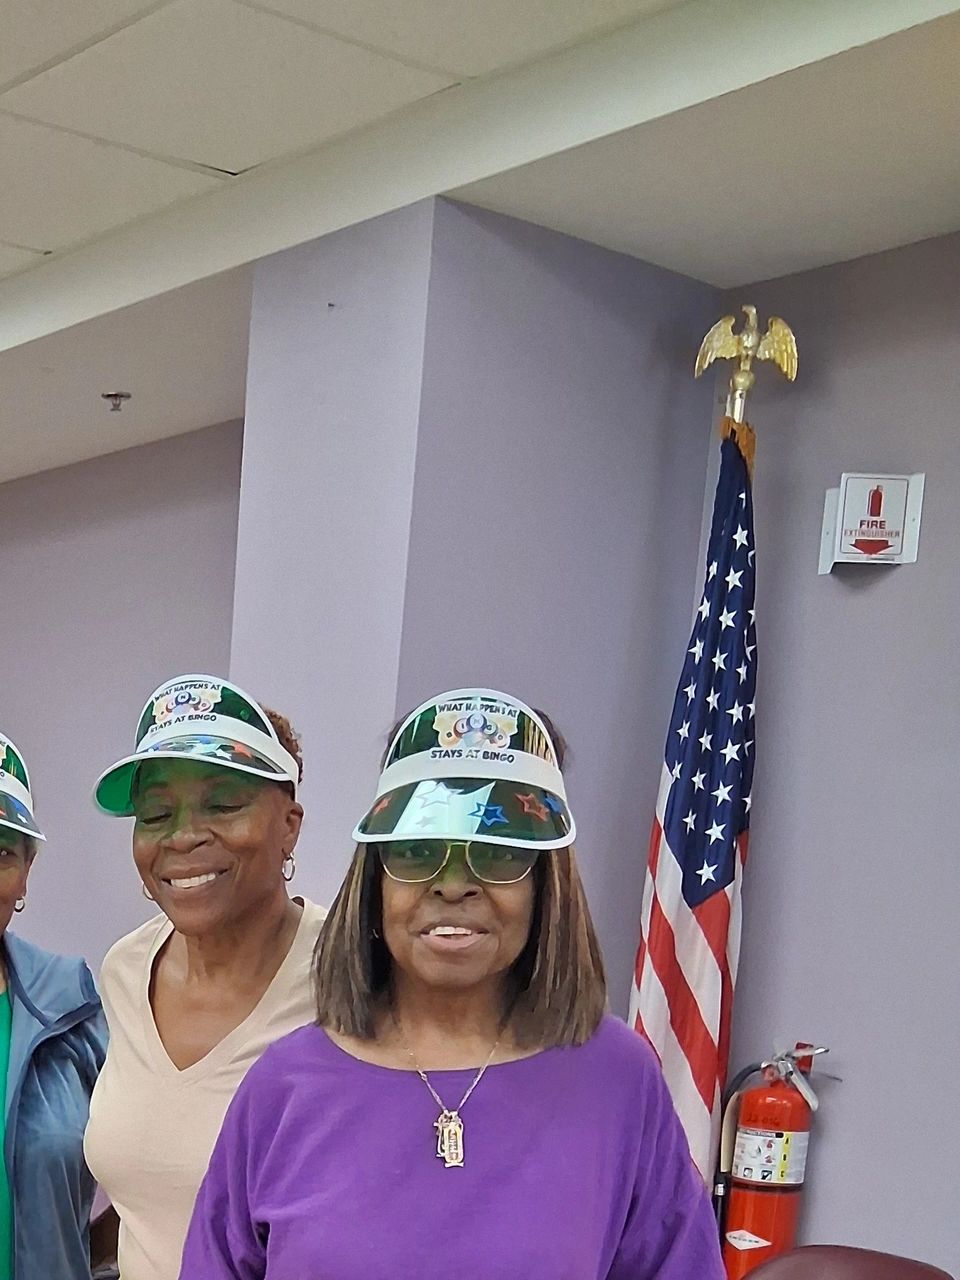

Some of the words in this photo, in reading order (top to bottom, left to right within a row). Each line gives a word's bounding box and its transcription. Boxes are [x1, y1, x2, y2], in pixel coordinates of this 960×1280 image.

[859, 519, 886, 529] FIRE
[844, 528, 900, 537] EXTINGUISHER
[154, 688, 173, 701] WHAT
[174, 683, 208, 692] HAPPENS
[438, 703, 464, 712] WHAT
[465, 703, 506, 715] HAPPENS
[507, 709, 518, 717] AT
[150, 719, 172, 733] STAYS
[174, 715, 186, 724] AT
[188, 714, 217, 722] BINGO
[430, 749, 463, 759] STAYS
[465, 749, 481, 758] AT
[482, 750, 515, 763] BINGO
